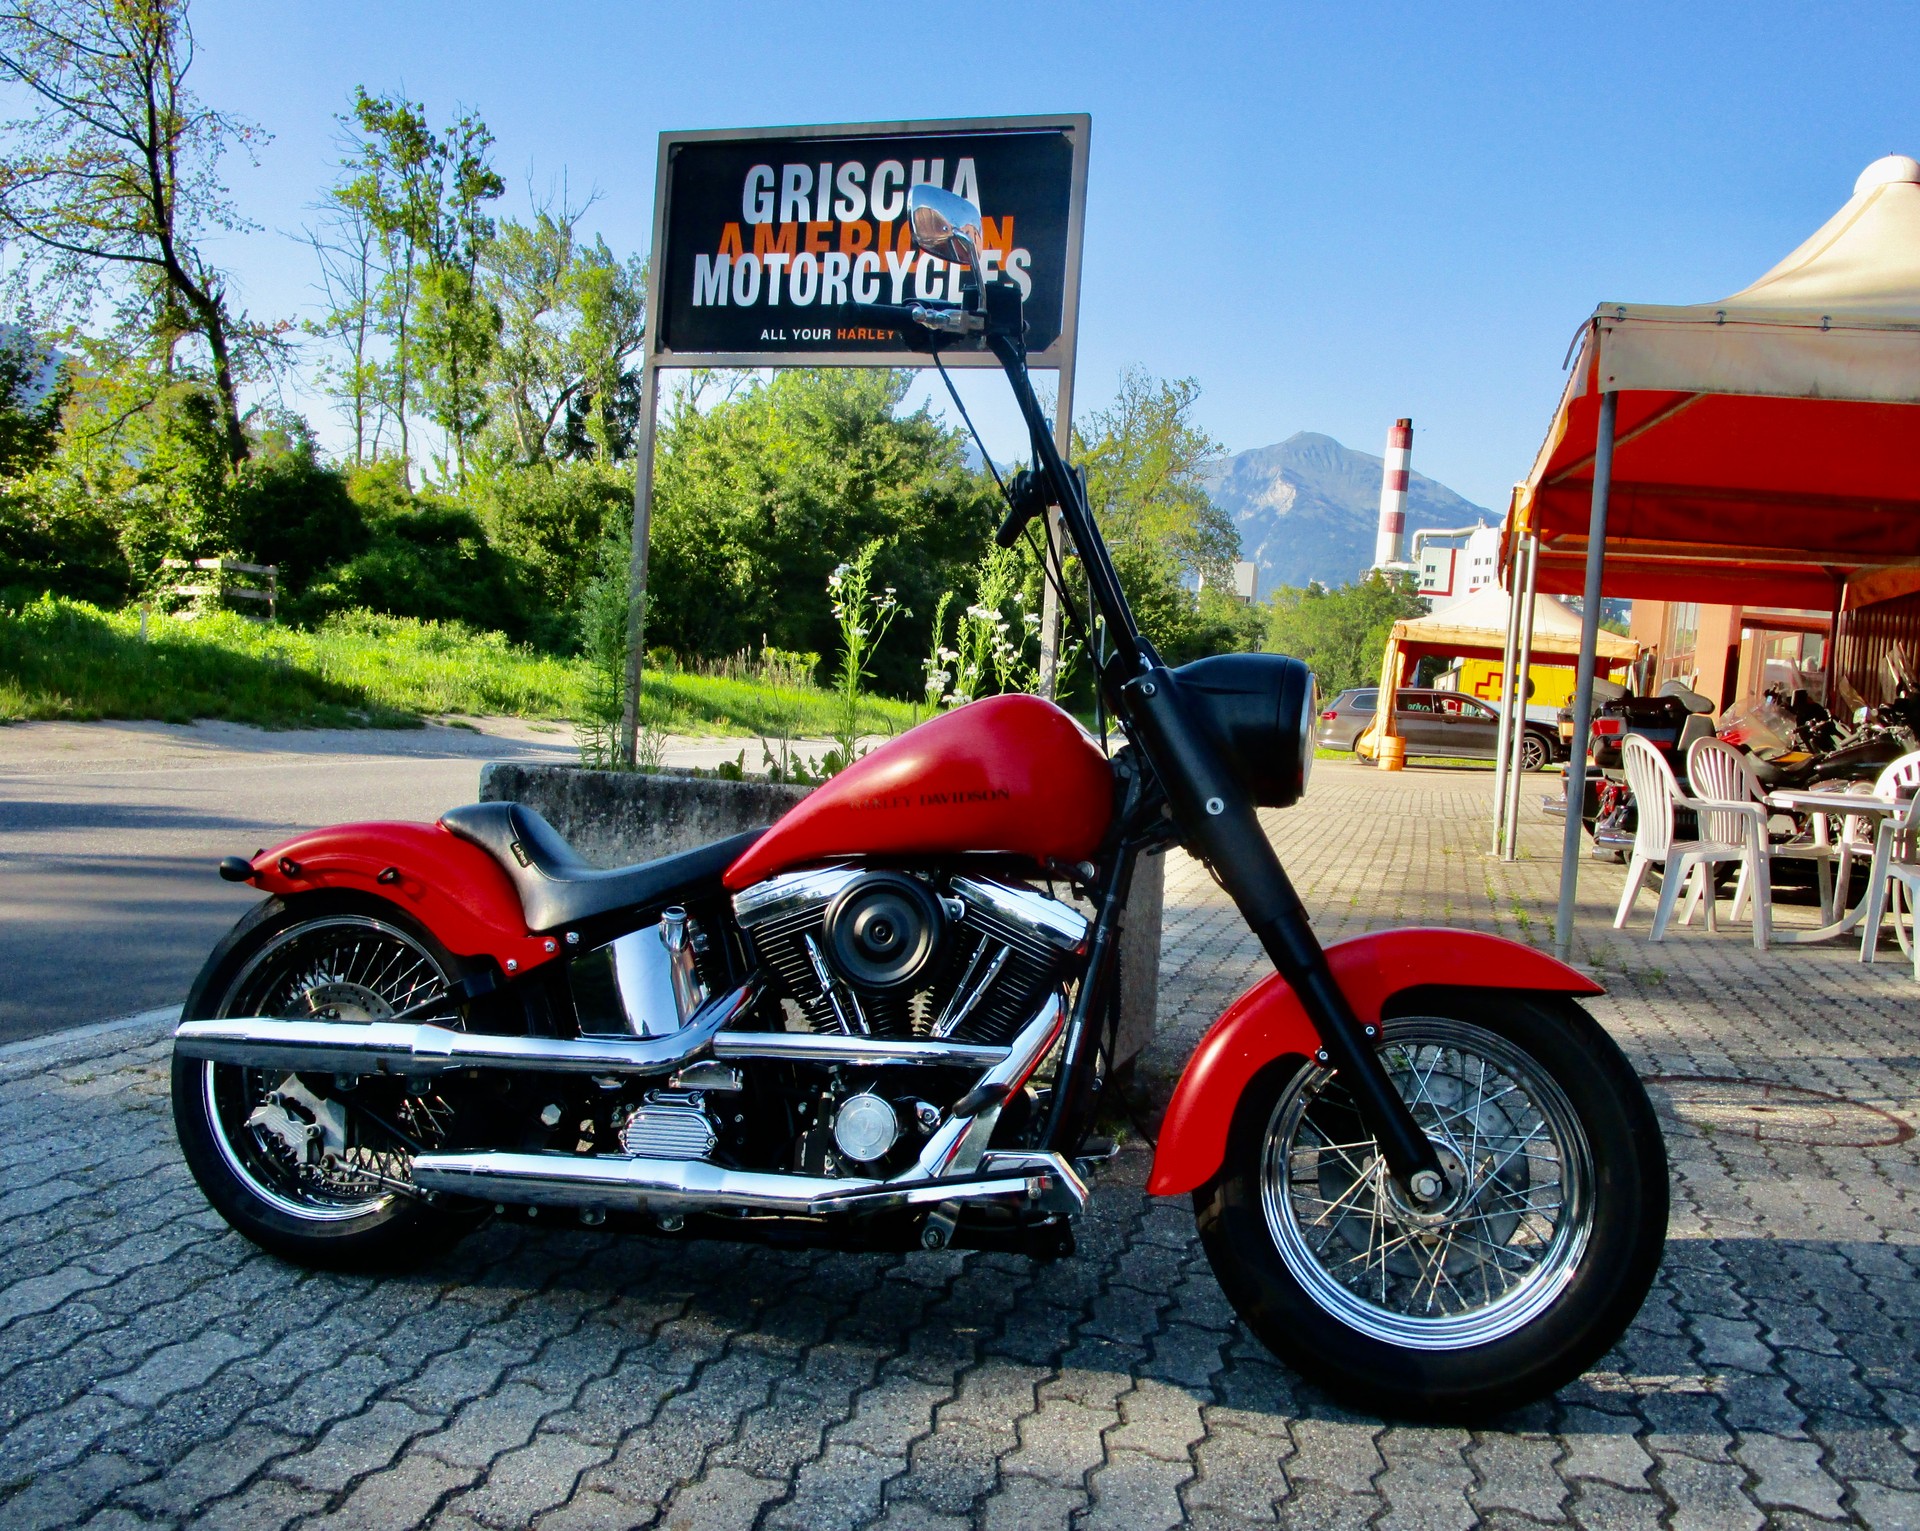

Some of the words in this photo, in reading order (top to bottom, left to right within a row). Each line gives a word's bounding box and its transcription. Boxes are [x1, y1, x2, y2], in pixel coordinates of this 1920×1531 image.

[715, 215, 1014, 275] AMERIN
[692, 248, 1032, 307] MOTORCYCLES
[760, 329, 787, 341] ALL
[792, 328, 832, 341] YOUR
[837, 327, 895, 341] HARLEY
[919, 789, 1009, 806] DAVIDSON
